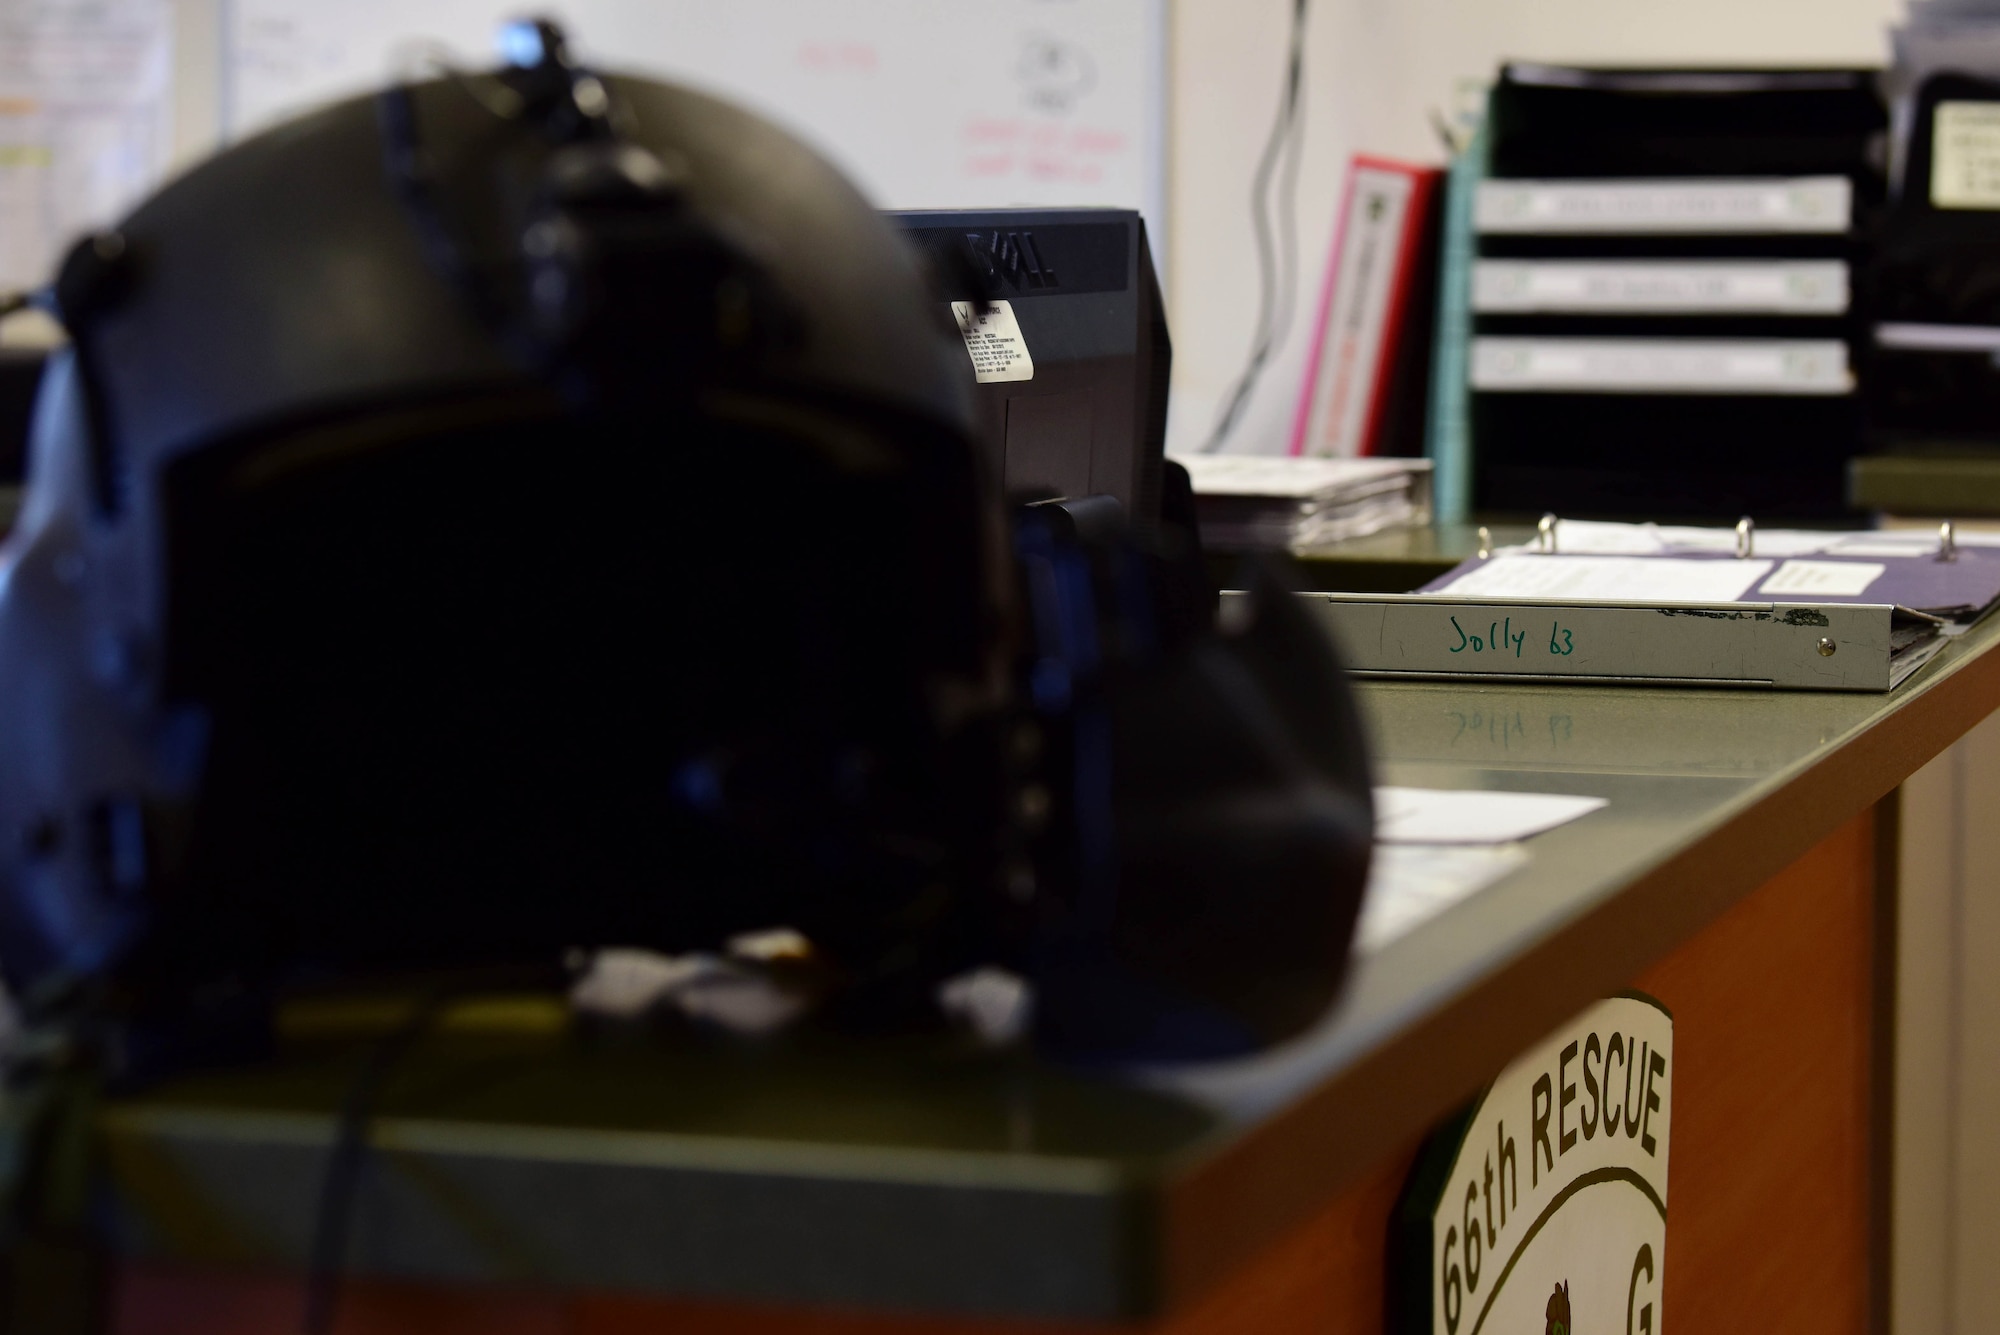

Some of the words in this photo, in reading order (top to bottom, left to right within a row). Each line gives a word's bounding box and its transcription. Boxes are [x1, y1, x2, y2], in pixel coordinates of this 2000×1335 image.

[1449, 616, 1525, 658] Jolly
[1550, 621, 1574, 655] 63
[1443, 1119, 1517, 1335] 66th
[1532, 1032, 1666, 1190] RESCUE
